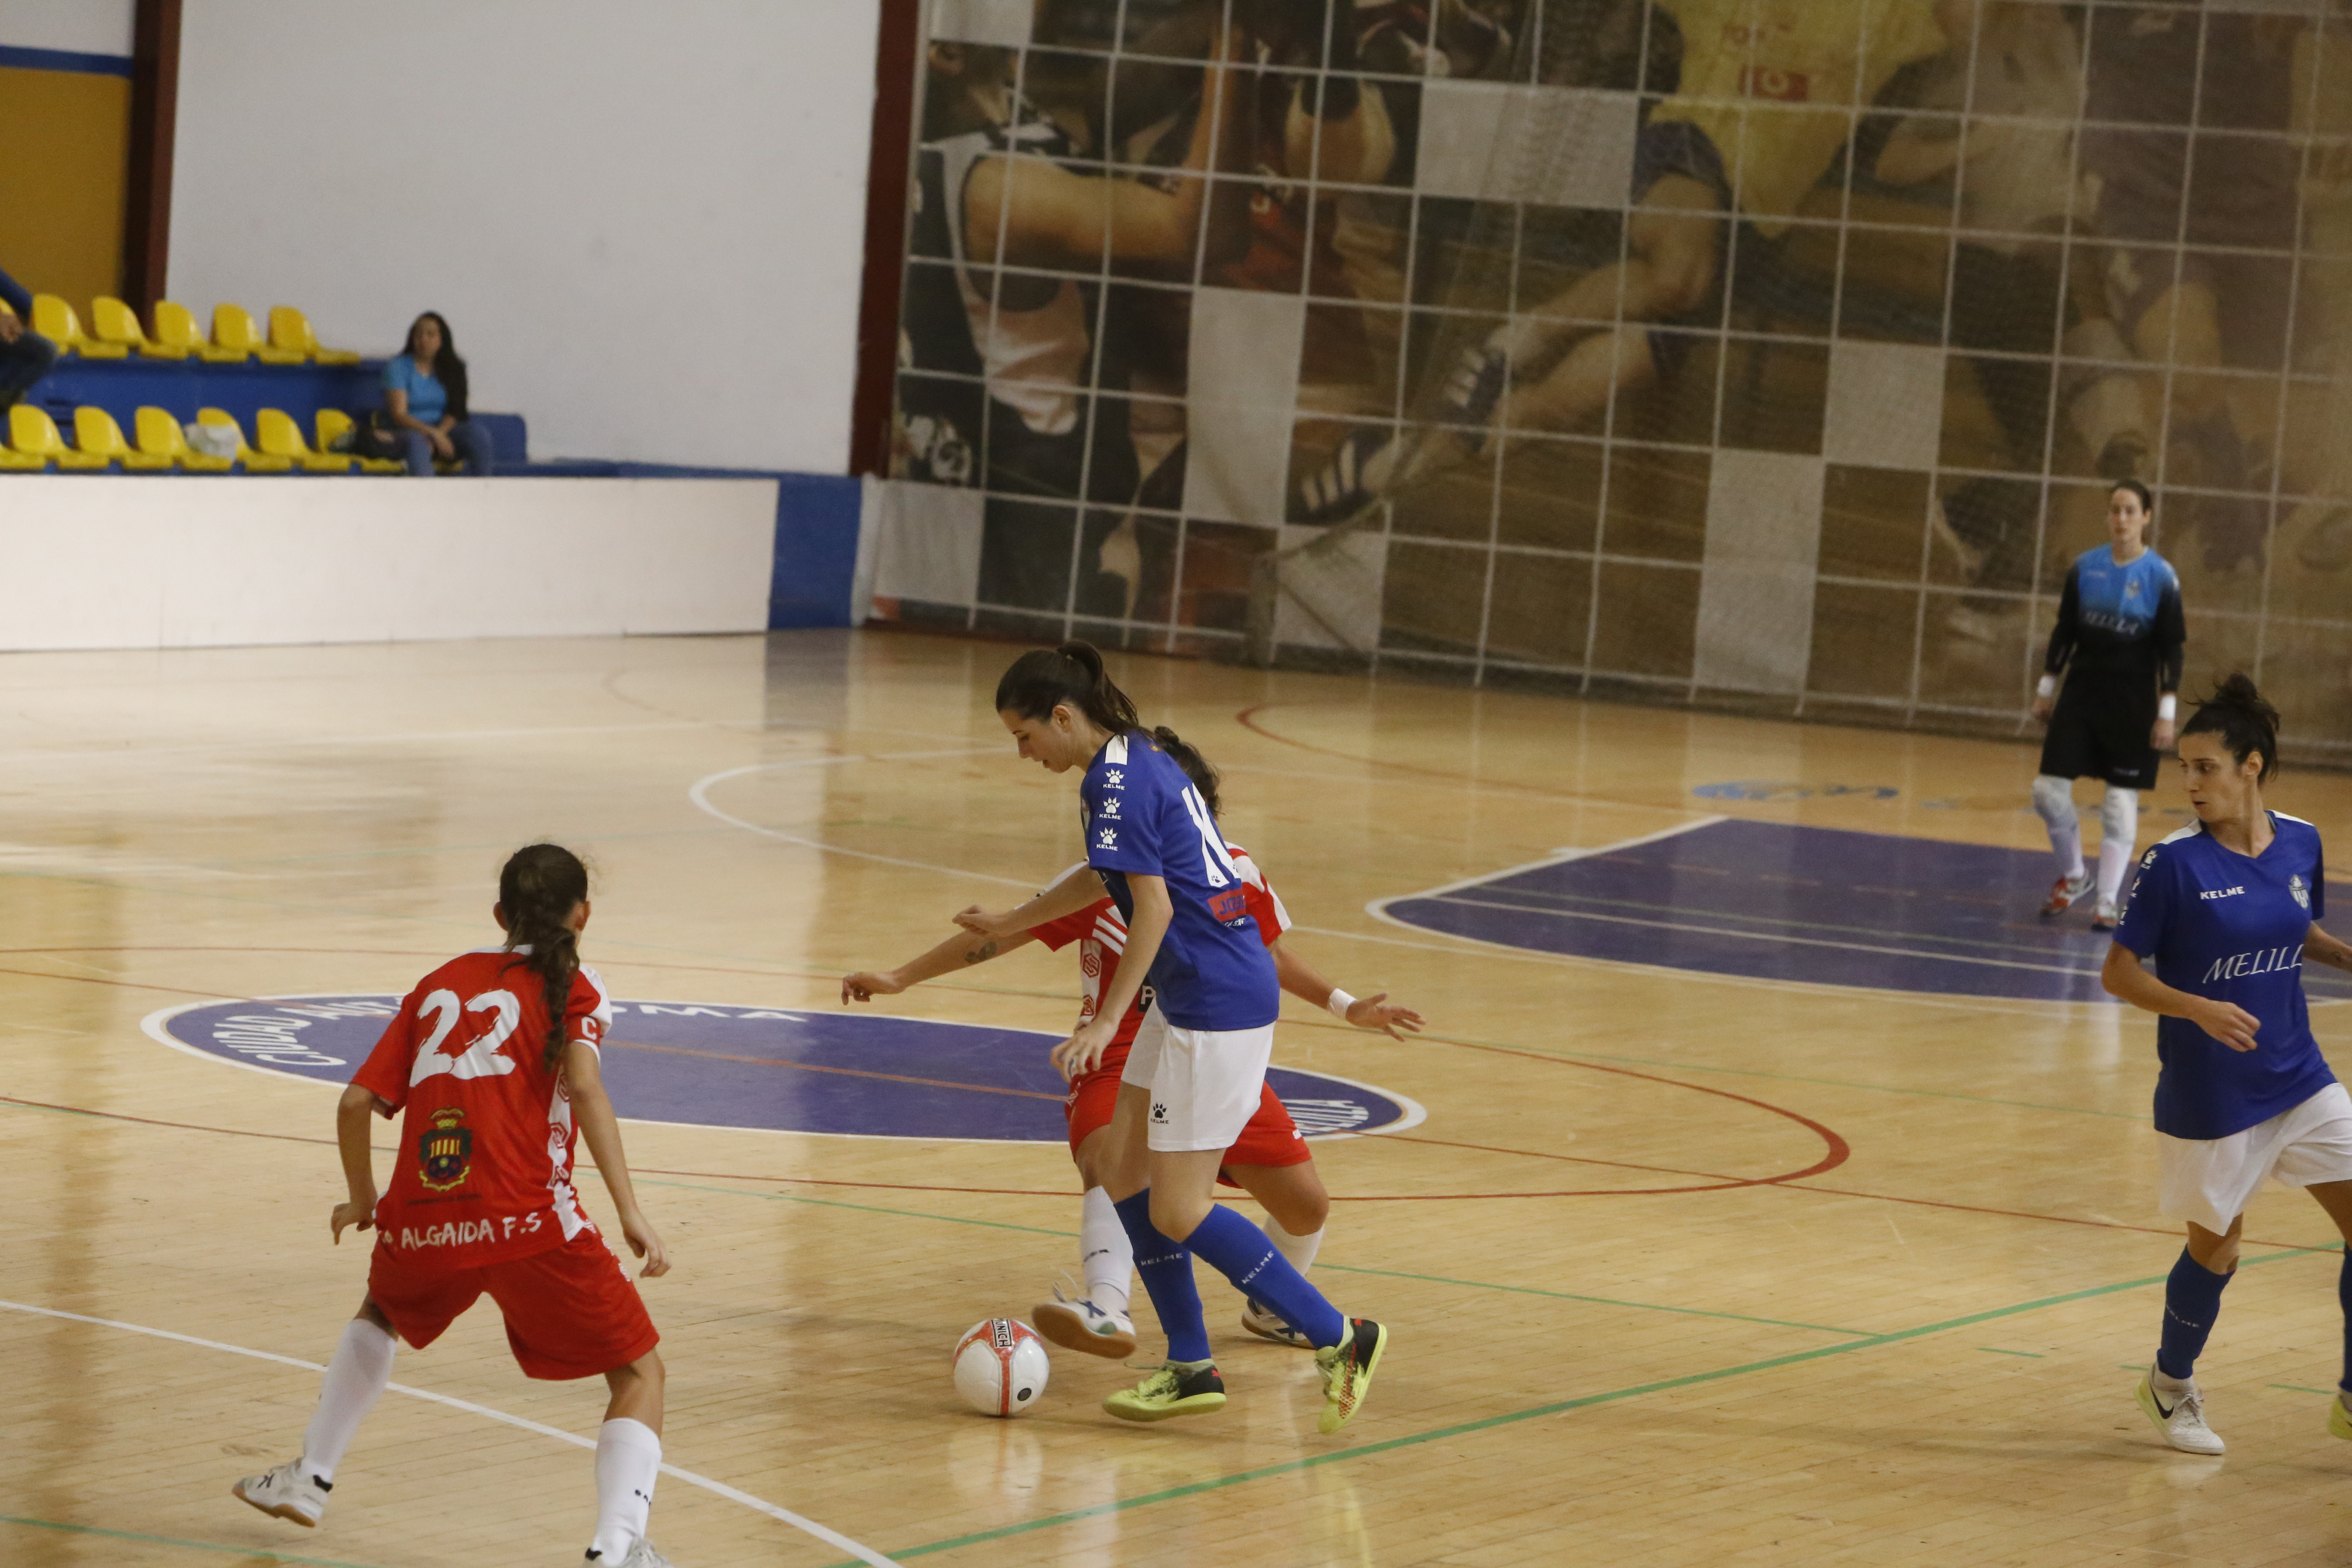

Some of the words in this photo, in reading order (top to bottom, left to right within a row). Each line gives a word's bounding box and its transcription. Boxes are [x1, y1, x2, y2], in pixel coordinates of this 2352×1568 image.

[2200, 886, 2245, 900] KELME
[409, 988, 521, 1087] 22
[401, 1218, 495, 1251] ALGAIDA
[502, 1212, 542, 1240] F.S
[1141, 1253, 1183, 1266] KELME
[1241, 1250, 1274, 1284] KELME
[995, 1318, 1012, 1348] UNICH
